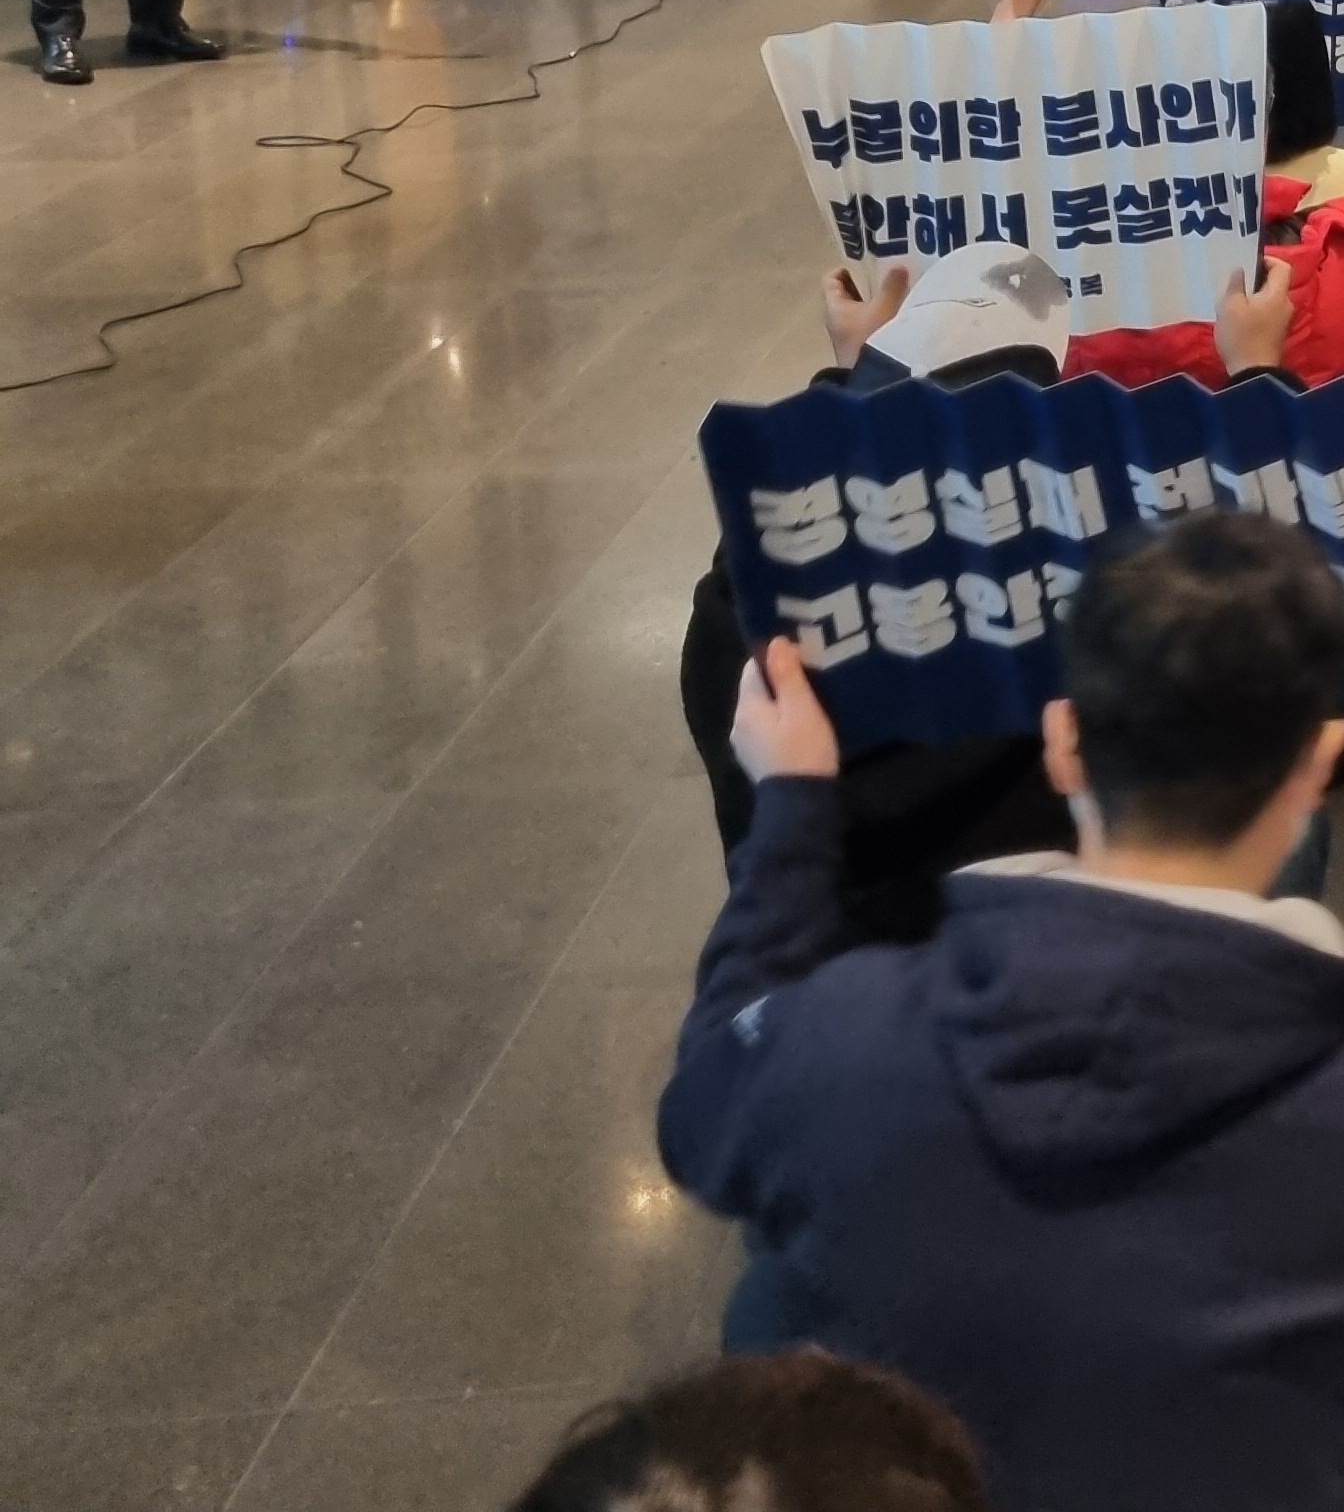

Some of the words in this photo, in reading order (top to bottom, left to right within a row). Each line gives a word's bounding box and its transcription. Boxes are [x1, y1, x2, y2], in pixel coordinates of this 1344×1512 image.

[803, 96, 1021, 168] 누굴위한
[1042, 79, 1257, 156] 분사인가
[750, 466, 1107, 566] 경영실패
[776, 561, 1082, 671] 고용안
